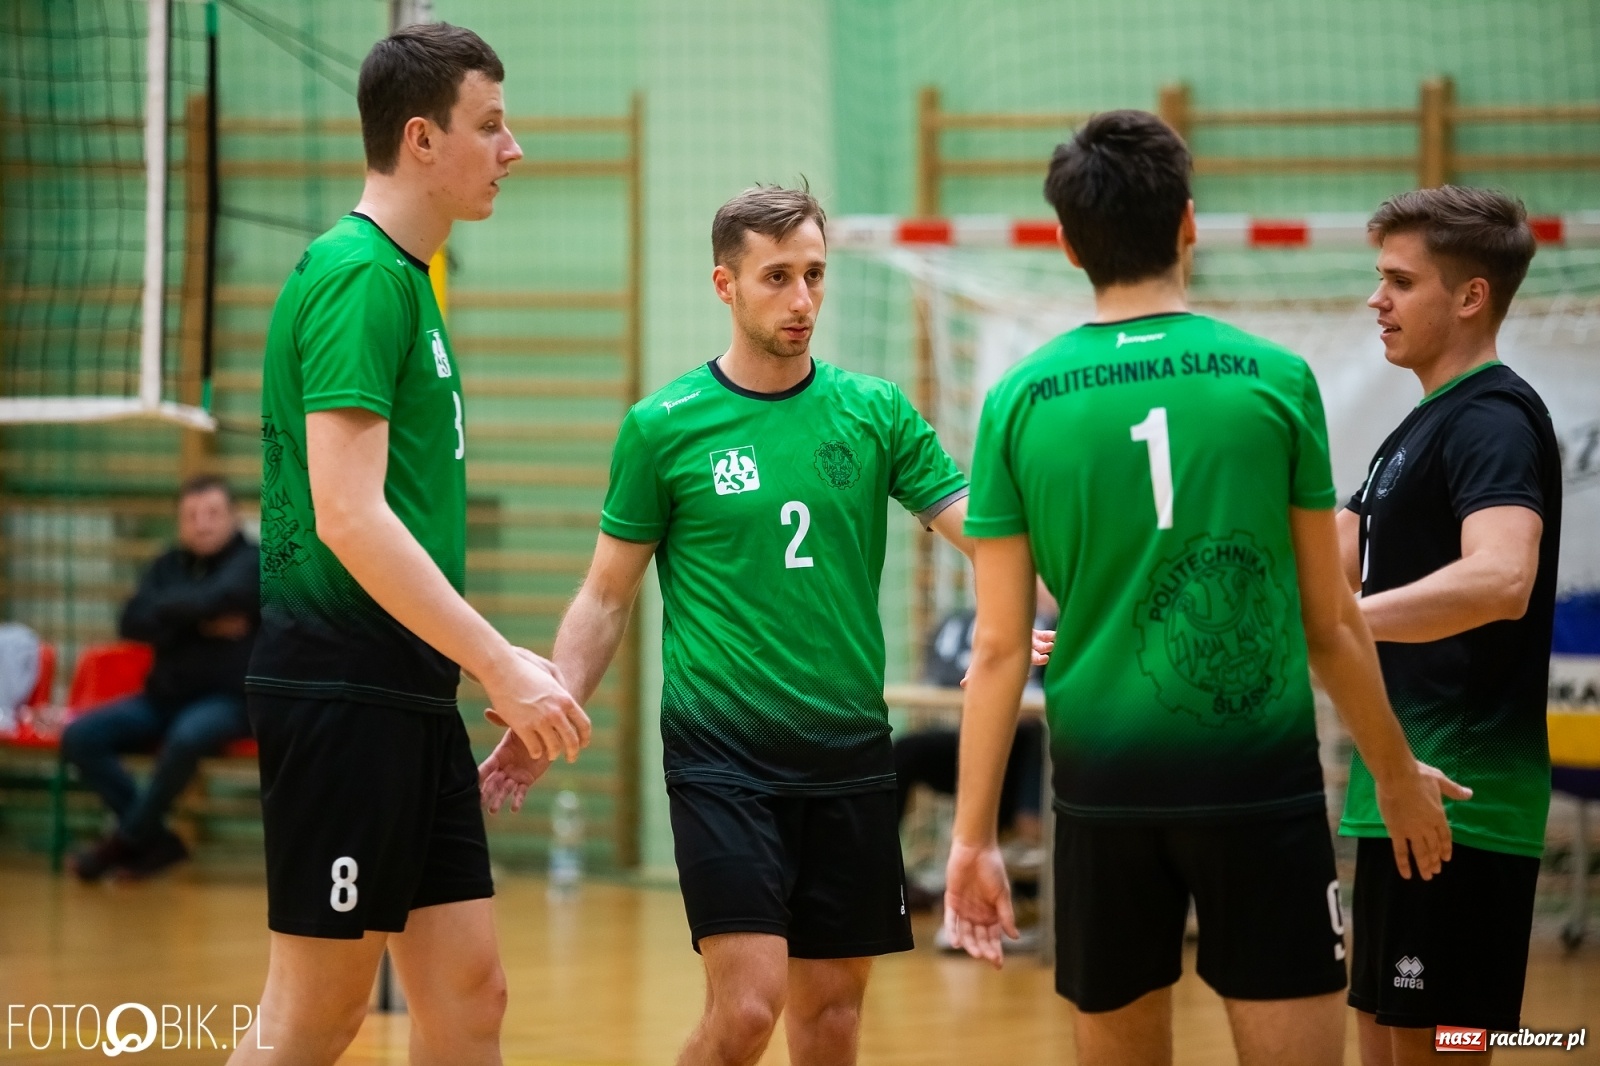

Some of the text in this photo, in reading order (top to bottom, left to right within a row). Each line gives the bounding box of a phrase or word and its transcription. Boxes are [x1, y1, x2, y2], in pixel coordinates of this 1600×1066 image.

[1028, 350, 1260, 406] POLITECHNIKA ŚLĄSKA
[1129, 406, 1174, 530] 1
[780, 500, 814, 569] 2
[330, 856, 358, 912] 8
